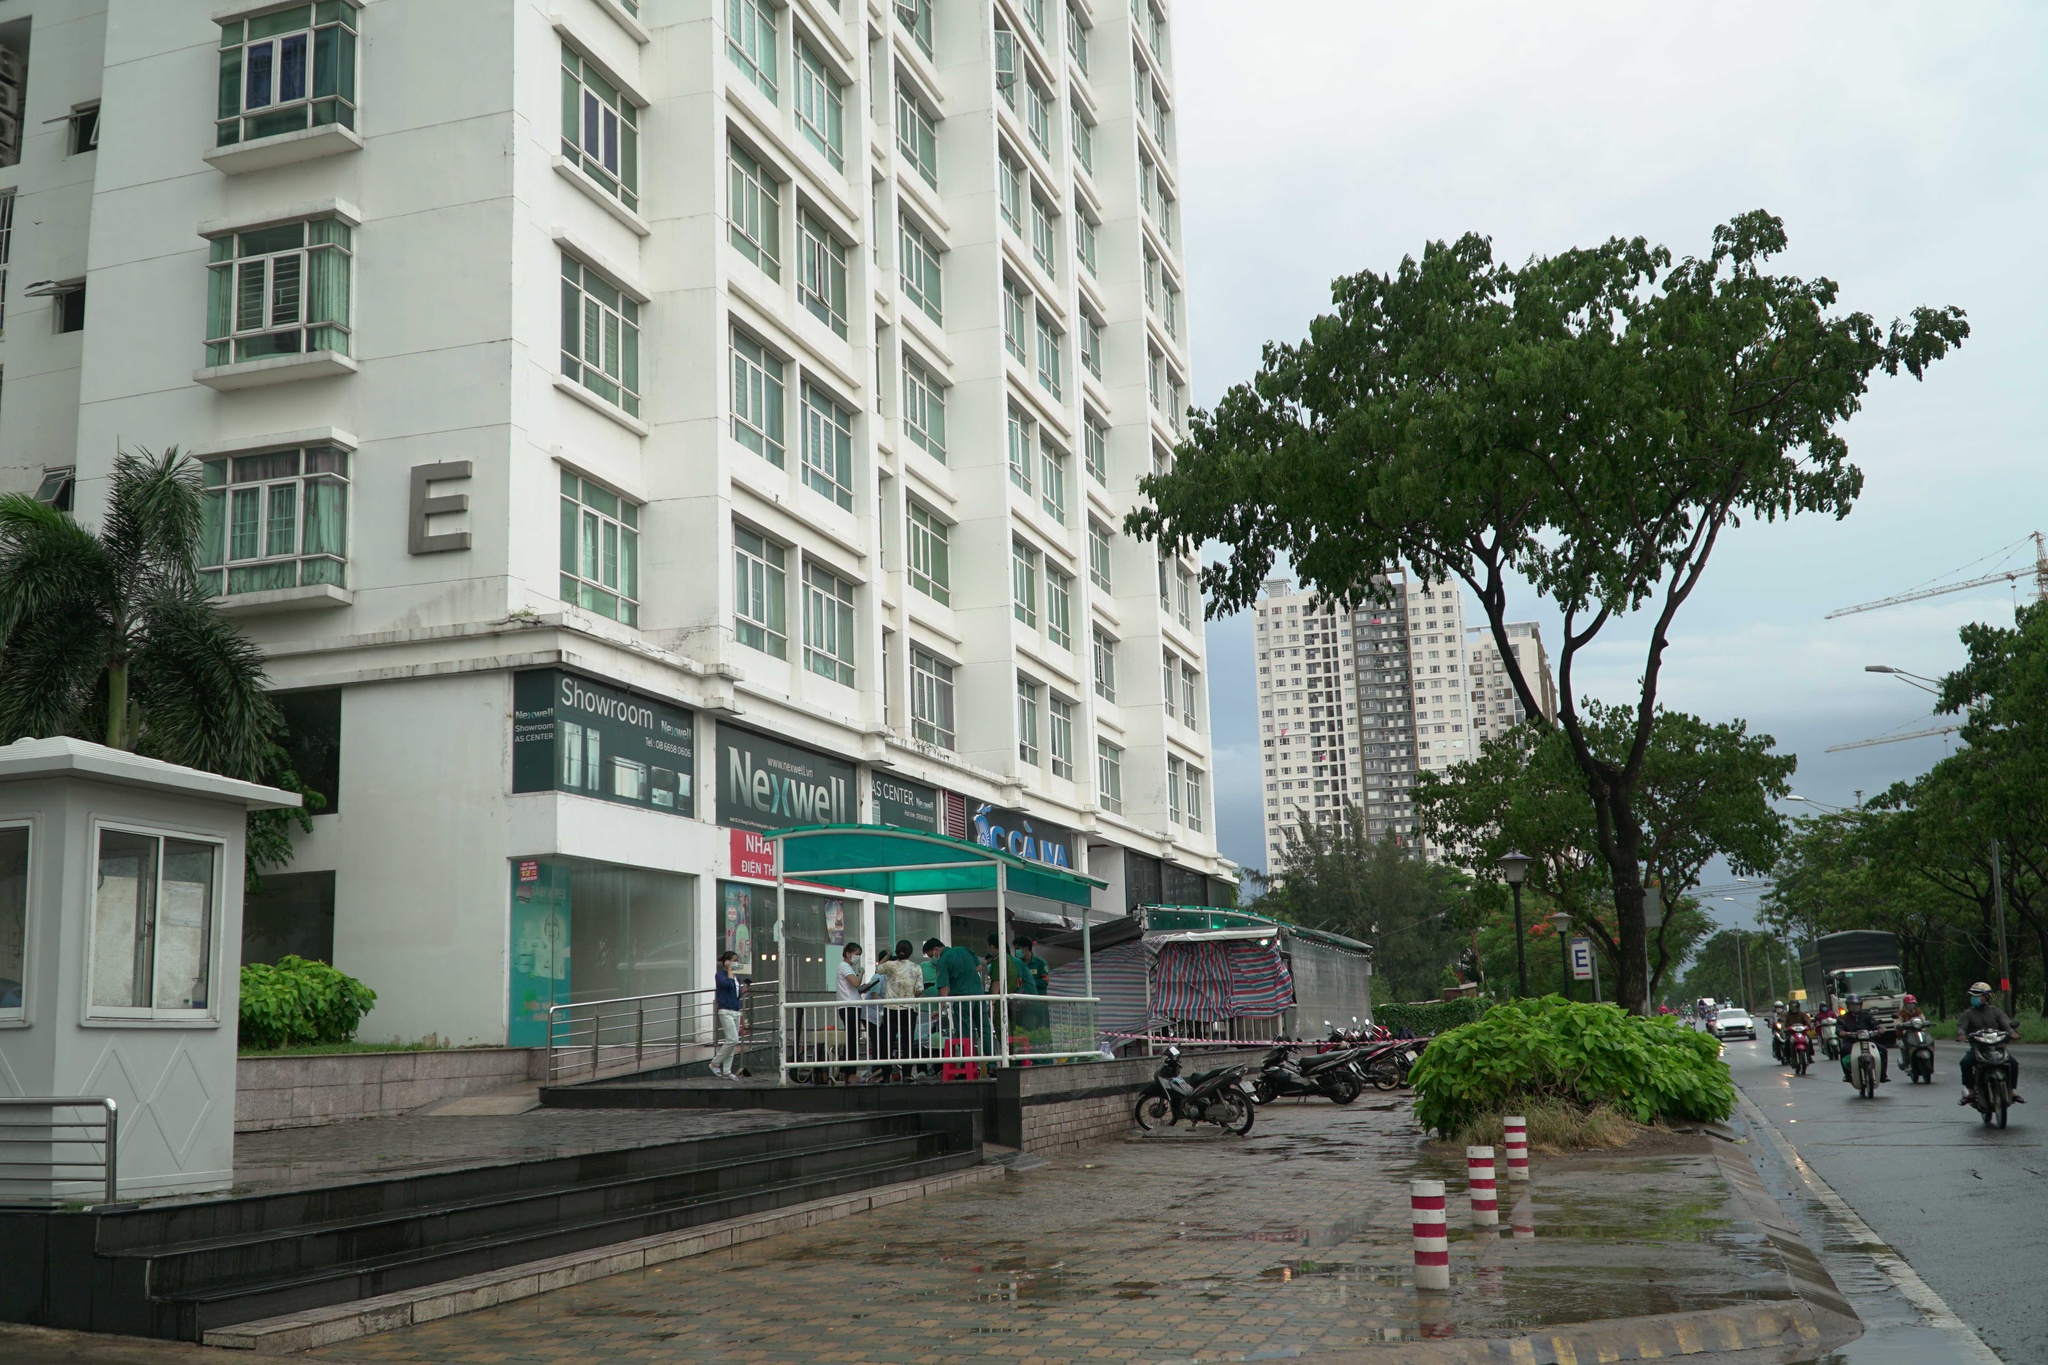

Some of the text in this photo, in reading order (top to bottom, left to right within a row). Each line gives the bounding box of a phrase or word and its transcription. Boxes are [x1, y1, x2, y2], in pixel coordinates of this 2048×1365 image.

[408, 460, 473, 555] E
[515, 707, 554, 720] Nexwell
[561, 677, 654, 730] Showroom
[514, 722, 554, 733] Showroom
[514, 732, 554, 743] AS CENTER
[660, 719, 692, 740] Nexwell
[655, 740, 664, 750] 08
[728, 745, 846, 825] Nexwell
[883, 783, 914, 807] CENTER
[1039, 839, 1068, 869] NA
[741, 859, 762, 877] ĐIỆN
[1574, 949, 1589, 968] E
